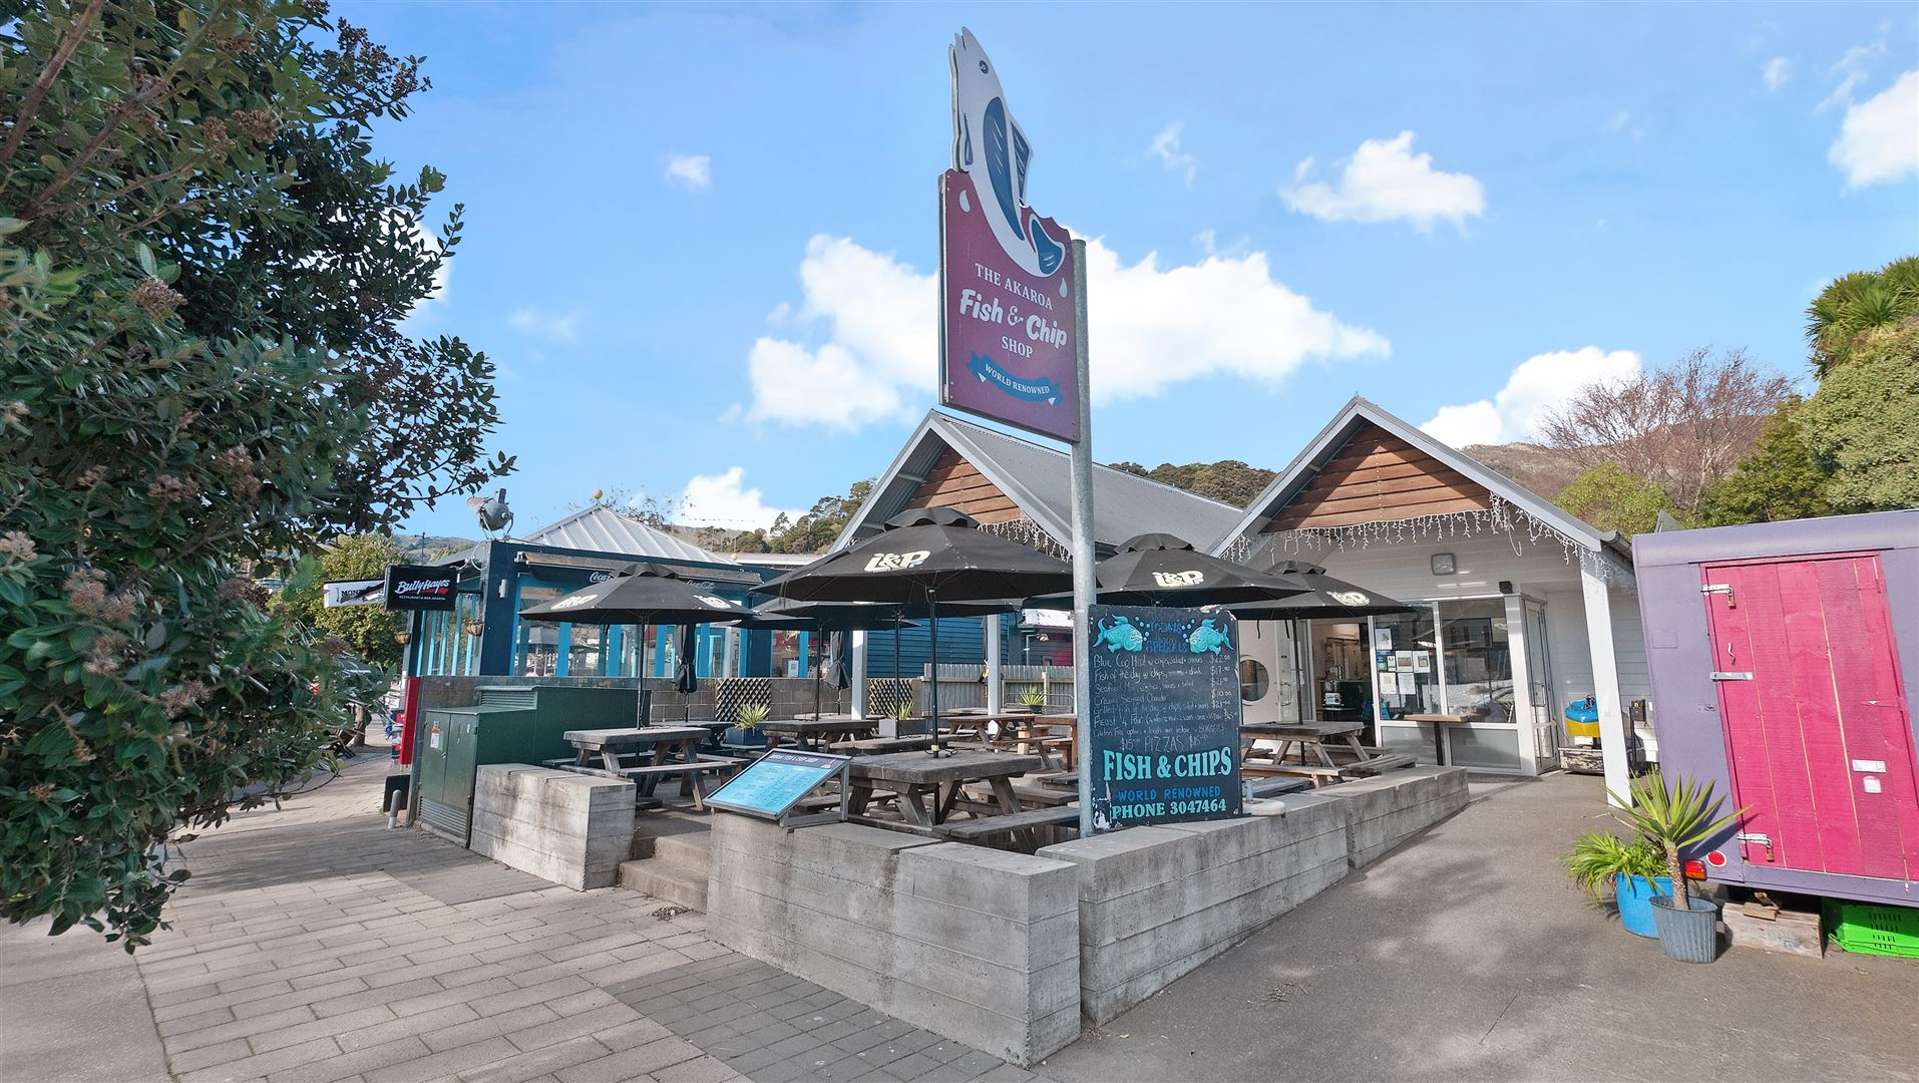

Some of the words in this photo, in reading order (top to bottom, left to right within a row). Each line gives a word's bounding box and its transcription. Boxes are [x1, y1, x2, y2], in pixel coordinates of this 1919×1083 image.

[975, 263, 1001, 286] THE
[1004, 278, 1054, 310] AKAROA
[960, 288, 1003, 324] Fish
[1007, 305, 1024, 326] &
[1026, 314, 1067, 349] Chip
[1001, 336, 1034, 359] SHOP
[985, 363, 1011, 387] WORLD
[1012, 381, 1050, 395] RENOWNED
[1144, 736, 1183, 753] PIZZAS
[1103, 749, 1152, 781] FISH
[1156, 755, 1172, 779] &
[1174, 746, 1232, 777] CHIPS
[1117, 788, 1158, 802] WORLD
[1163, 785, 1221, 800] RENOWNED
[1111, 802, 1166, 820] PHONE
[1169, 799, 1227, 816] 3047464
